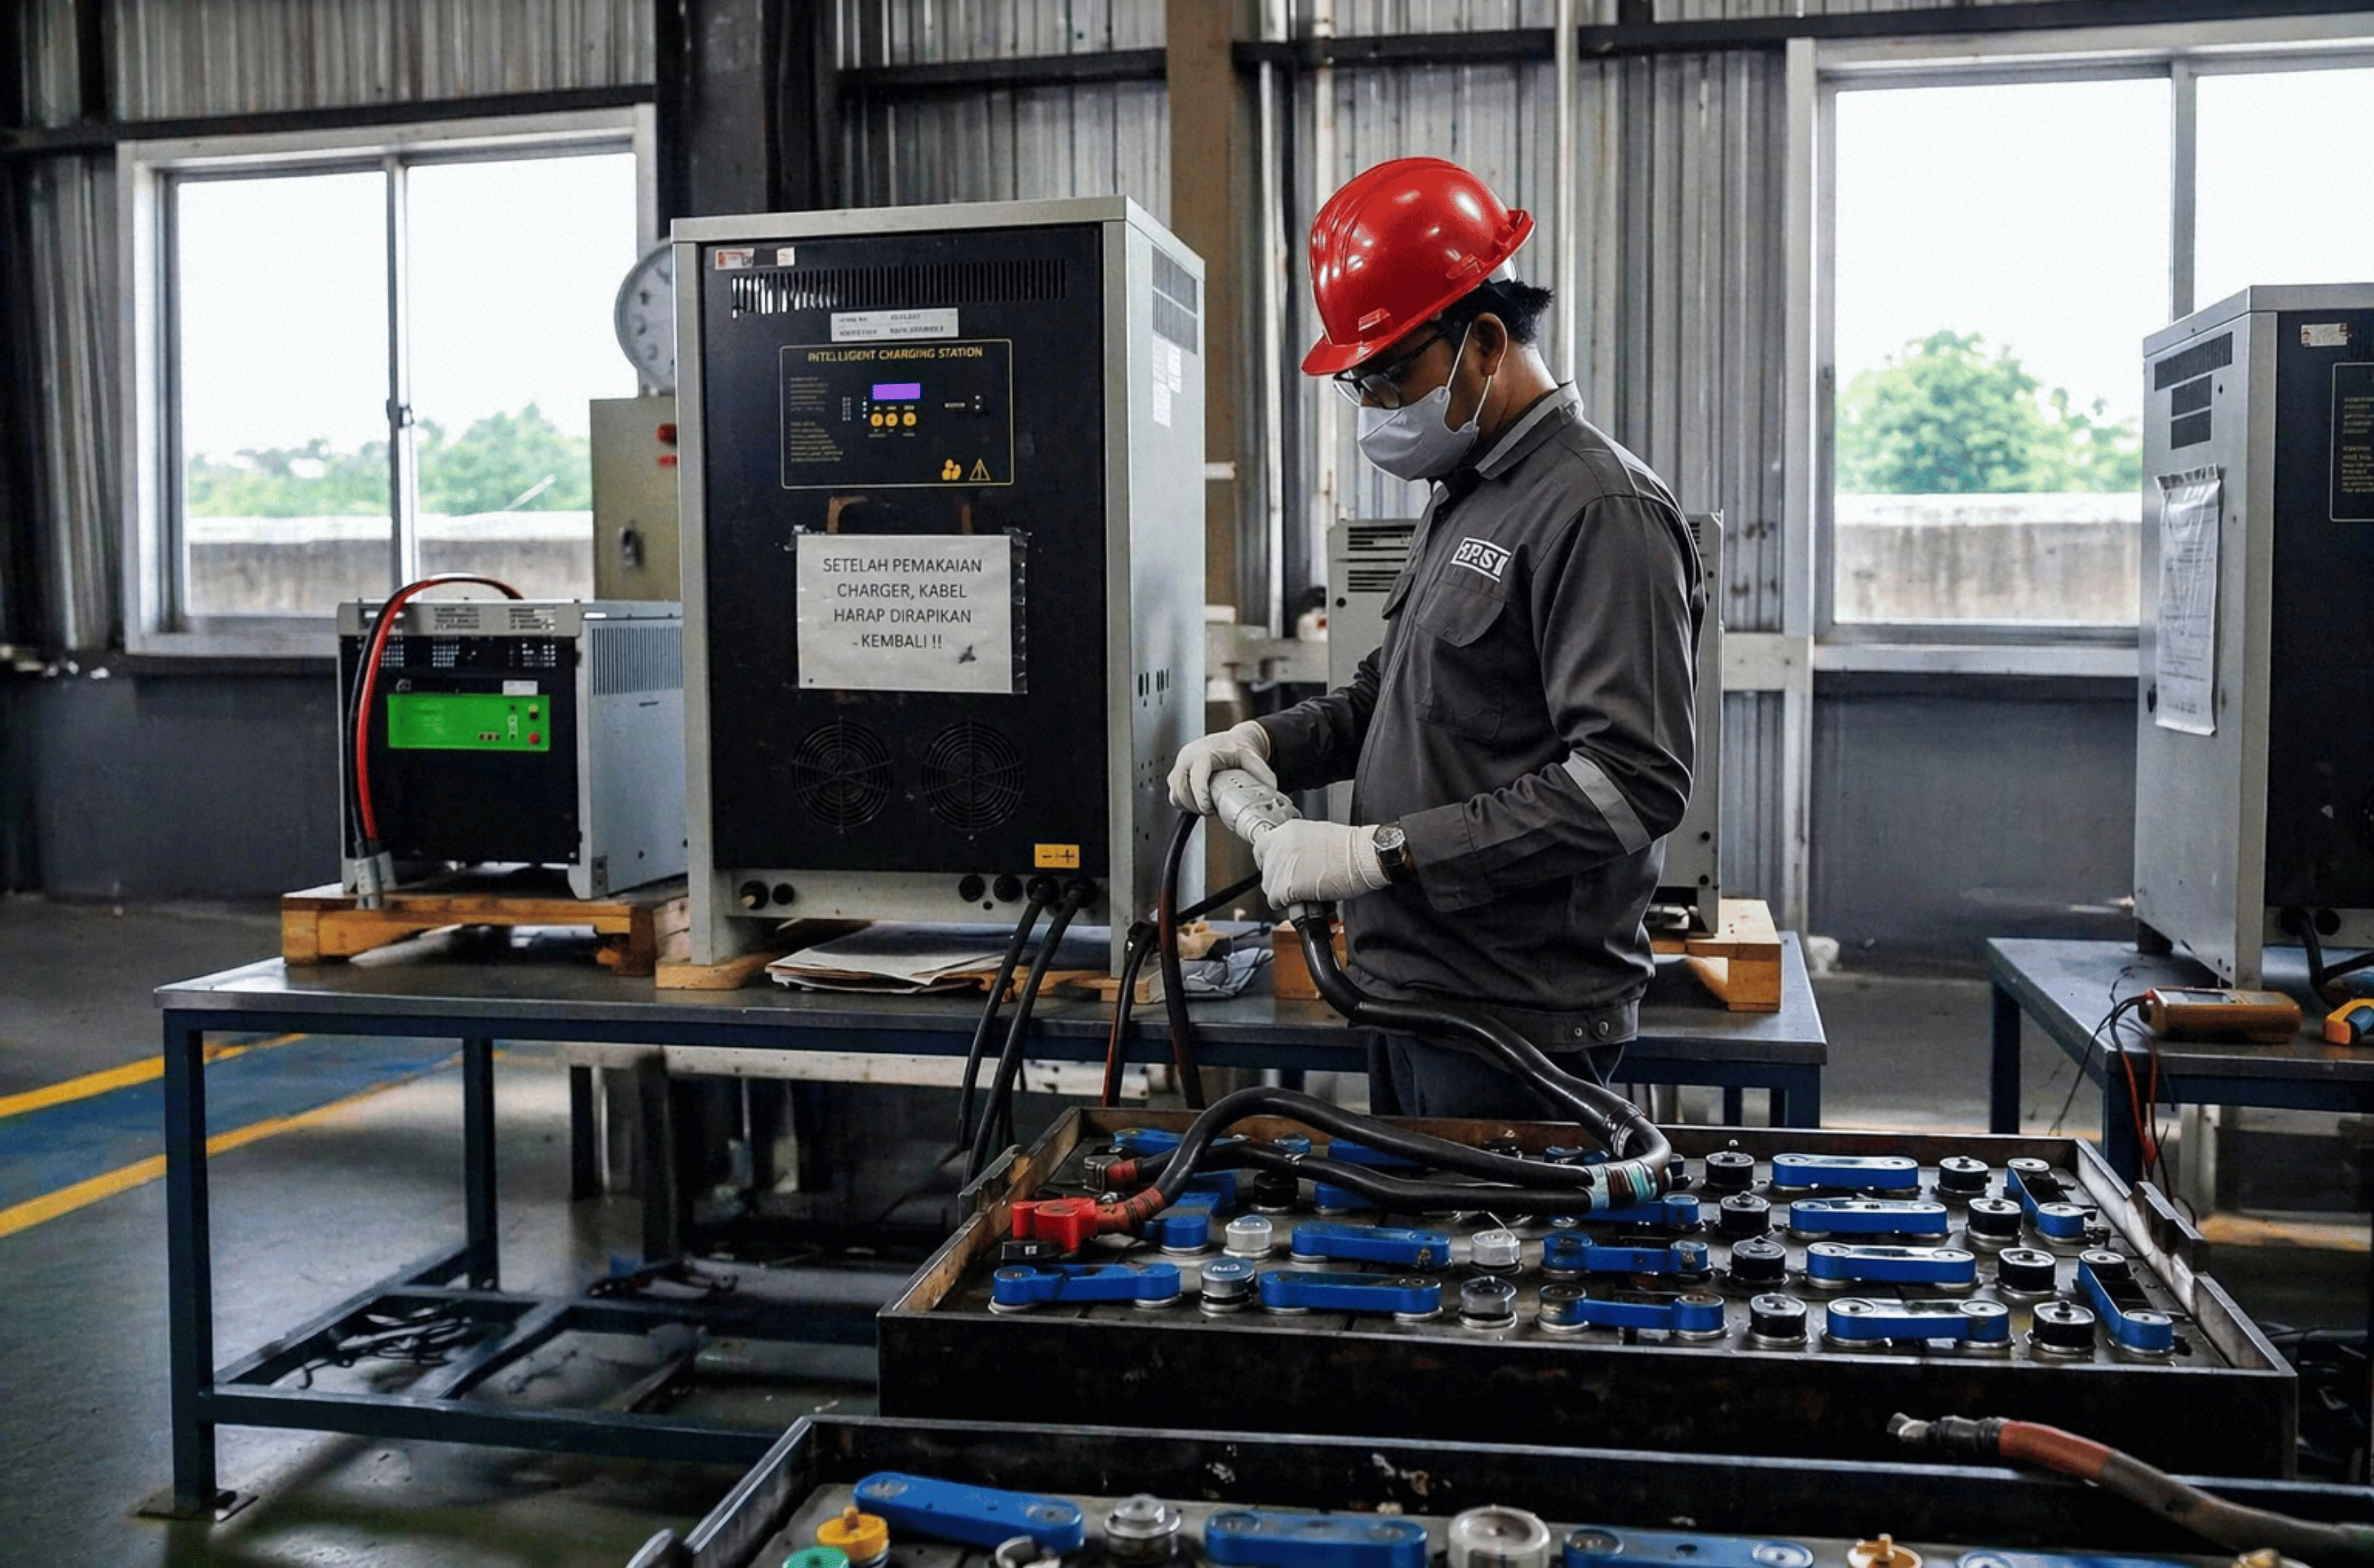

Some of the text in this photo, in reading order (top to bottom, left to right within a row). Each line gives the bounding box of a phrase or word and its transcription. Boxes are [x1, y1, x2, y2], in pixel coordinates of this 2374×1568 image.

[808, 347, 983, 362] INTELLIGENT CHARGING STATION
[823, 558, 983, 573] SETELAH PEMAKAIAN
[837, 583, 967, 601] CHARGER, KABEL
[834, 608, 972, 623] HARAP DIRAPIKAN
[862, 634, 927, 649] KEMBALI
